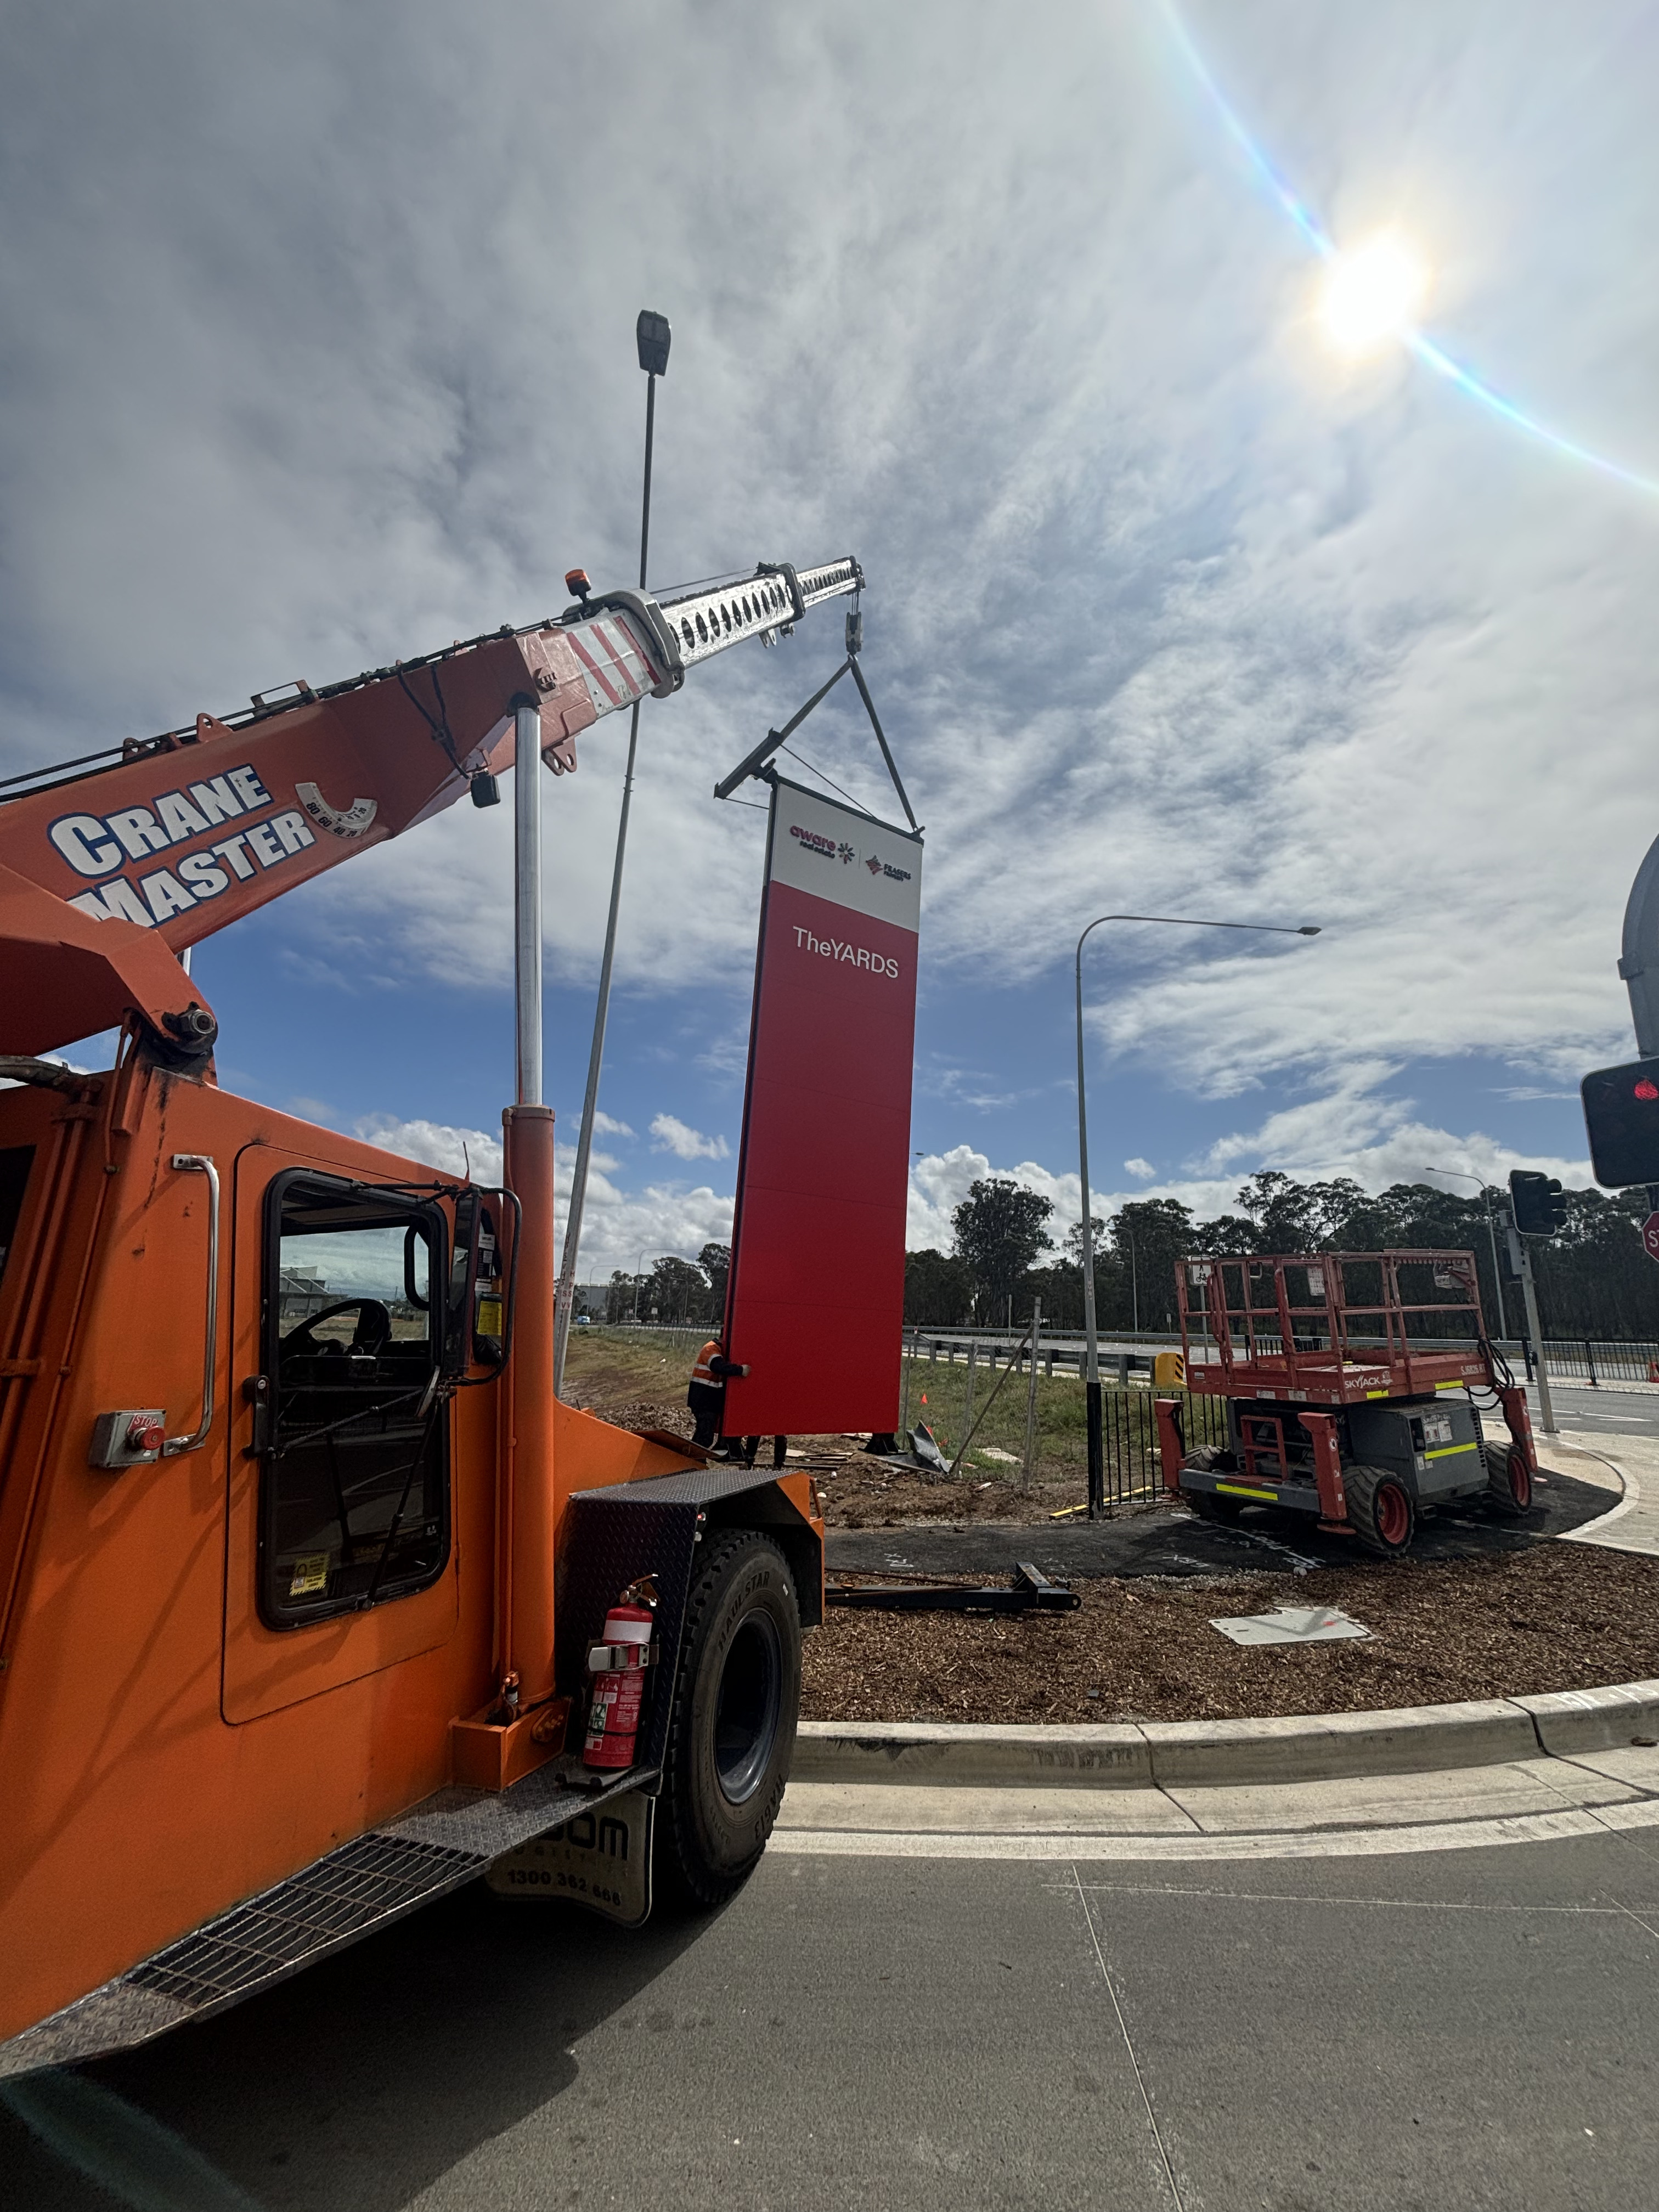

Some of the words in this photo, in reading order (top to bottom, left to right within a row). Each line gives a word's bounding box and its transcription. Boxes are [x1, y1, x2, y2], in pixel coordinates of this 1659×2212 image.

[306, 802, 320, 815] 80
[48, 764, 273, 878] CRANE
[318, 816, 332, 827] 60
[333, 826, 346, 835] 40
[790, 825, 836, 851] aware
[67, 810, 315, 929] MASTER
[884, 864, 911, 880] FRASERS
[793, 925, 899, 979] TheYARDS
[1345, 1375, 1381, 1389] SKYJACK
[134, 1414, 158, 1426] STOP
[507, 1869, 551, 1884] 1300
